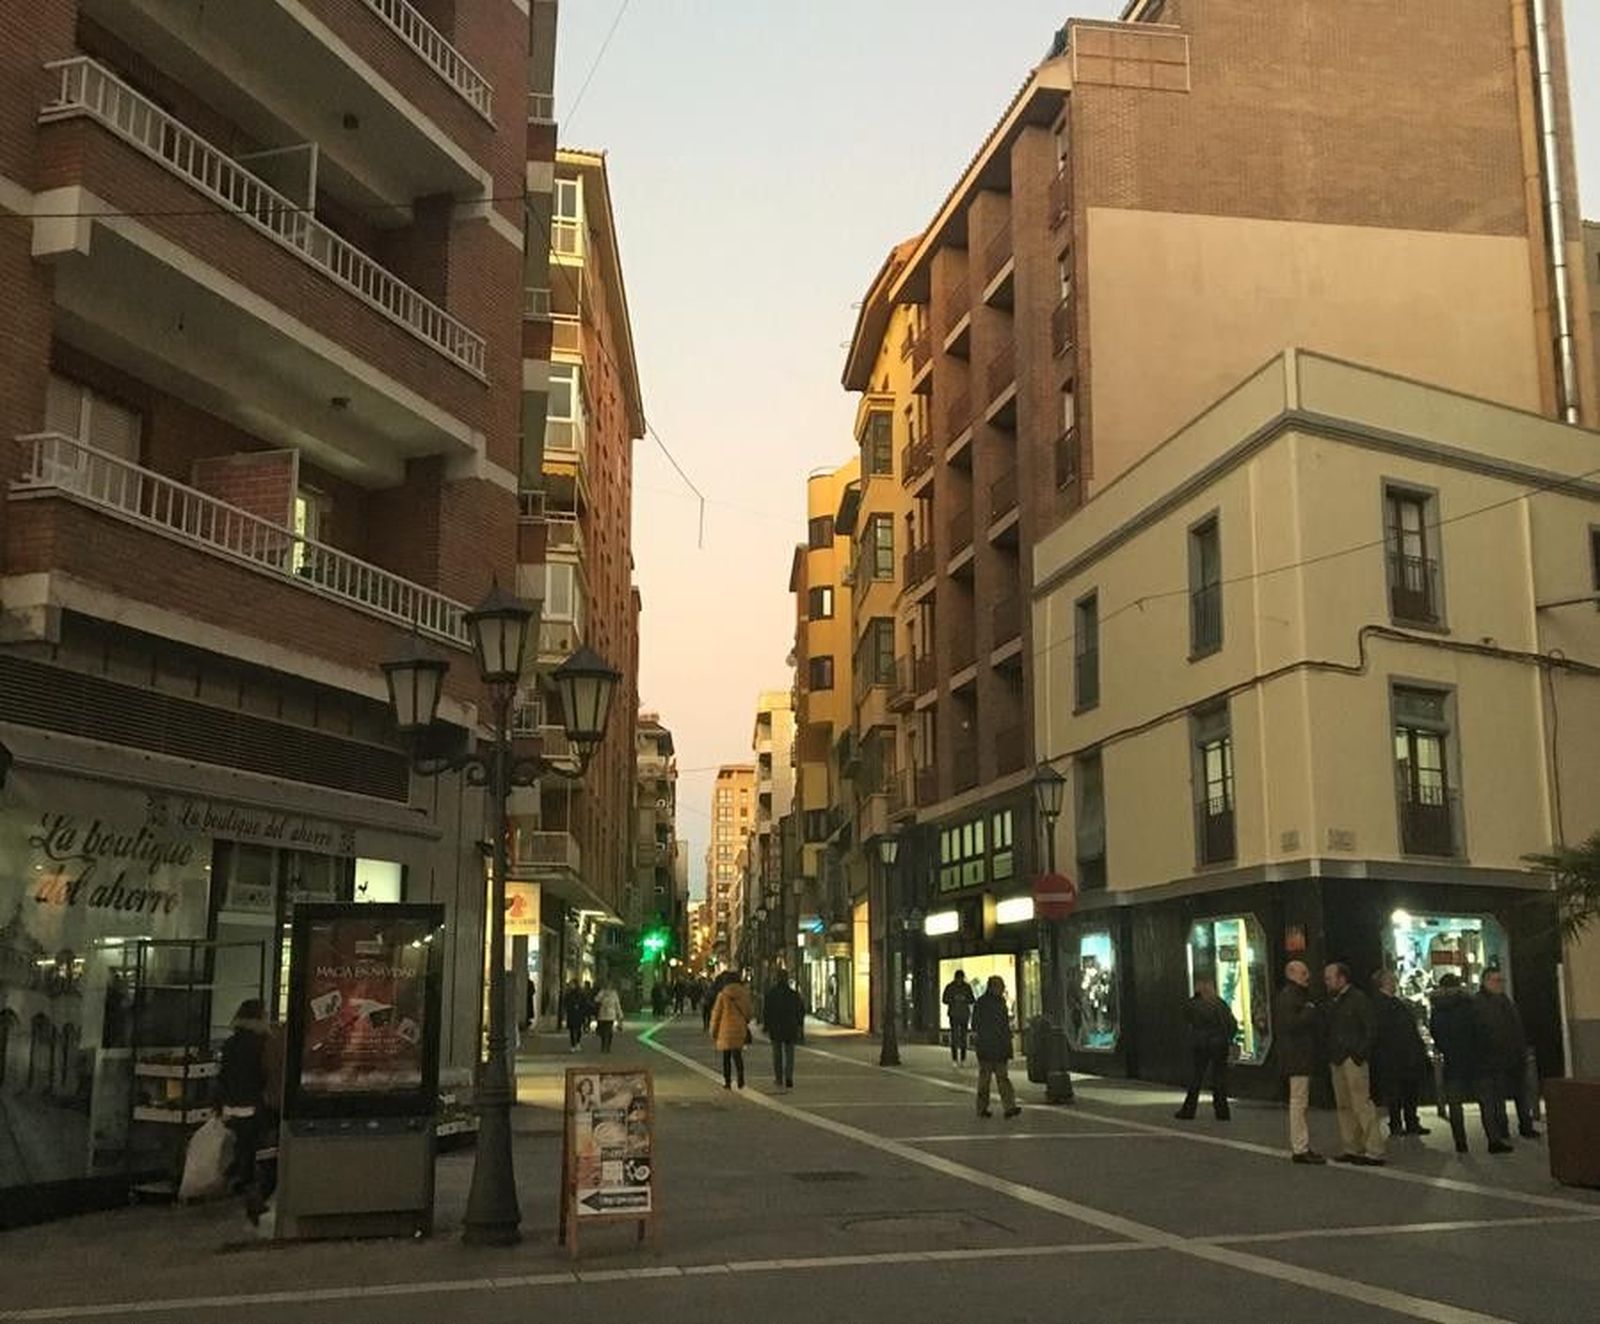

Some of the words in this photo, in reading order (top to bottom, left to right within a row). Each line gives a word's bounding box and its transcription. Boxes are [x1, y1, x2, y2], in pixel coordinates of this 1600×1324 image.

[29, 812, 82, 861] La
[202, 801, 260, 837] boutique
[265, 815, 289, 840] del
[291, 817, 333, 846] ahorro
[83, 819, 194, 875] boutique
[35, 864, 95, 906] del
[88, 871, 179, 914] ahorro
